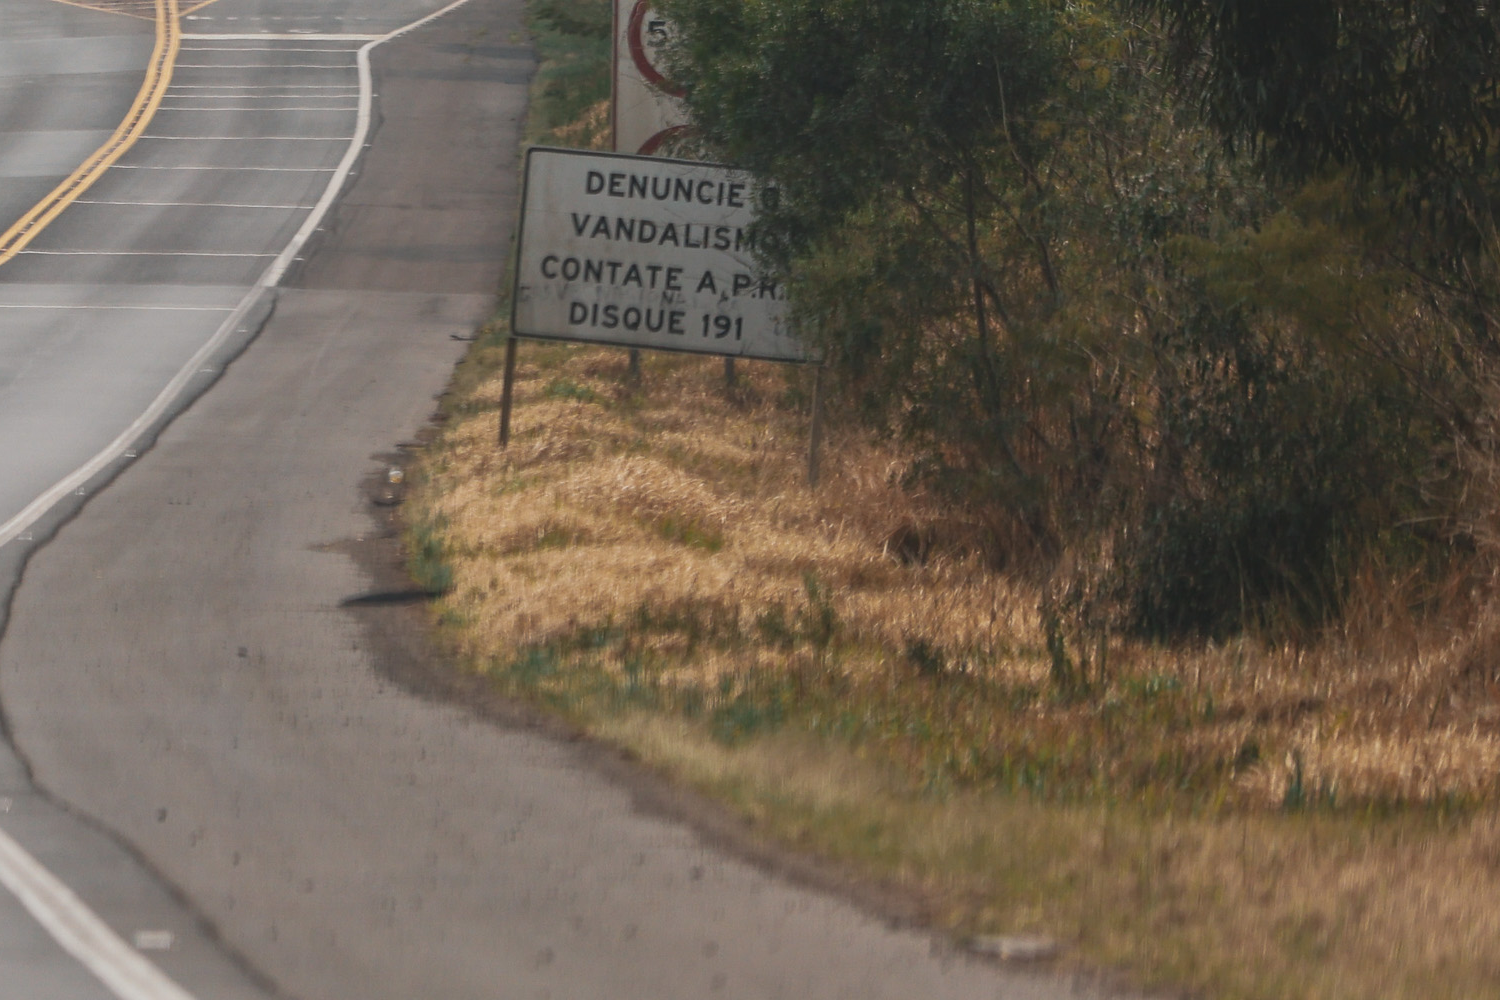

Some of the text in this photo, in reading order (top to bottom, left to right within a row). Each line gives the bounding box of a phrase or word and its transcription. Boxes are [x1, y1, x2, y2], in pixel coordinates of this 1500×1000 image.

[585, 171, 746, 208] DENUNCIE
[570, 212, 760, 252] VANDALISM
[541, 255, 684, 291] CONTATE
[695, 269, 717, 295] A
[569, 301, 744, 341] DISQUE 191
